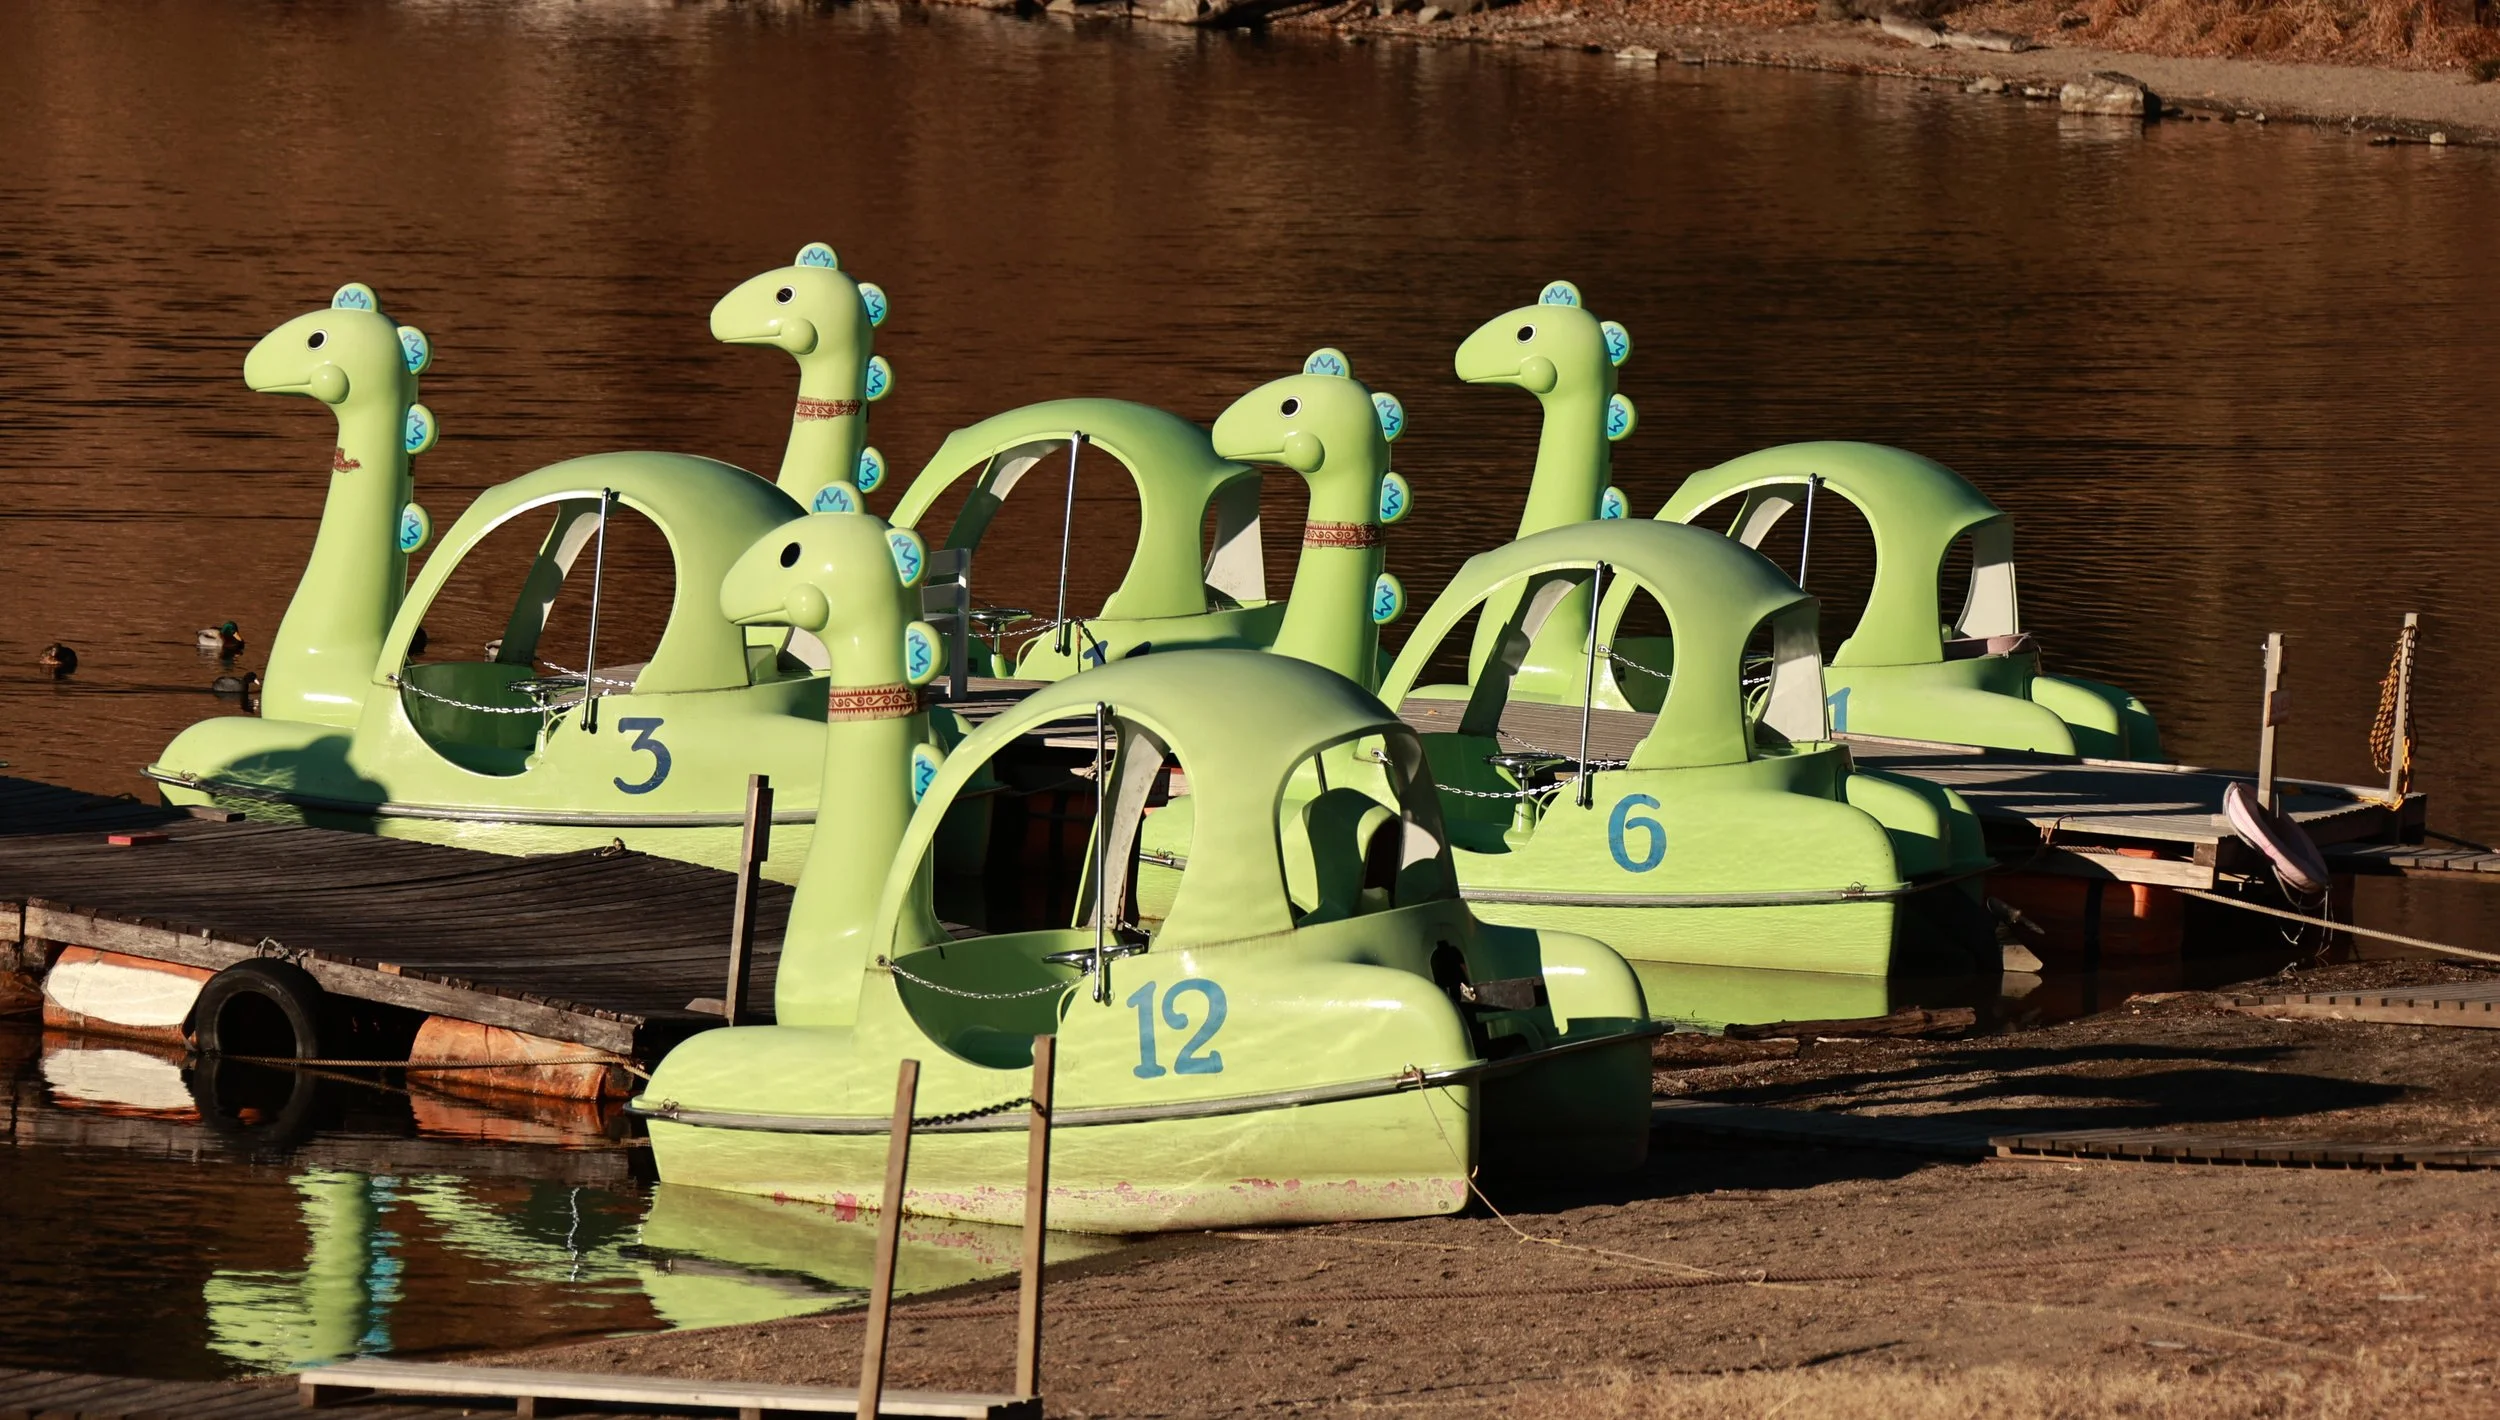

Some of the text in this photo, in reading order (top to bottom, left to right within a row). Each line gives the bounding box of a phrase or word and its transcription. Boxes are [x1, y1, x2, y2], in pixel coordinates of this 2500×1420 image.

[613, 717, 672, 795] 3
[1608, 793, 1667, 873] 6
[1126, 978, 1228, 1079] 12
